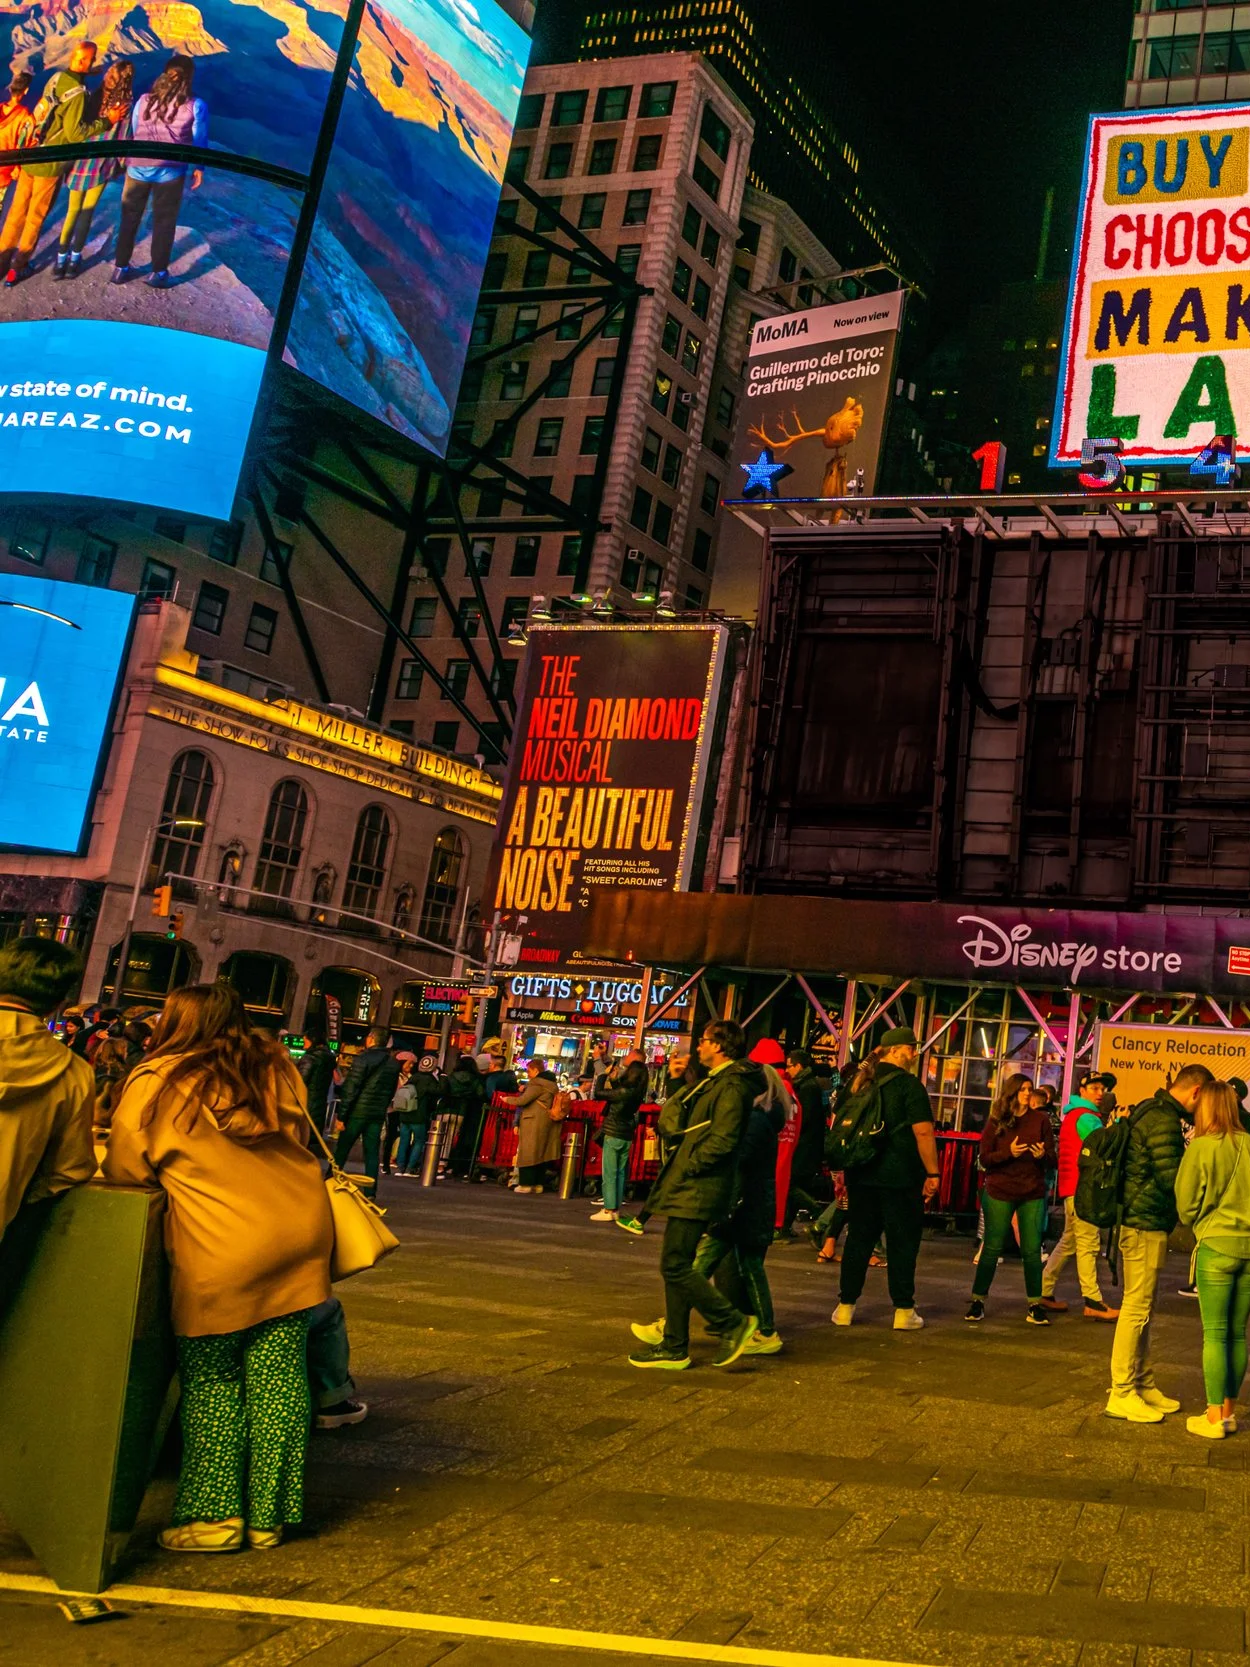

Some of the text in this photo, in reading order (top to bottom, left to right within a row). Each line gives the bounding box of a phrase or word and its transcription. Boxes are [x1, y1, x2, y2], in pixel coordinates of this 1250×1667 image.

[1117, 134, 1233, 195] BUY
[756, 310, 890, 344] MoMA Now on view
[747, 361, 880, 398] Crafting Pinocchio
[750, 346, 884, 381] Guillermo del Toro:
[10, 380, 71, 397] state
[75, 381, 107, 399] of
[110, 386, 193, 413] mind.
[0, 411, 192, 444] AREAZ.COM
[539, 655, 581, 696] THE
[528, 697, 702, 741] NEIL DIAMOND
[172, 704, 200, 726] THE
[203, 716, 245, 740] SHOW
[250, 732, 289, 756] FOLKS
[295, 747, 329, 769] SHOE
[331, 759, 363, 779] SHOP
[316, 714, 384, 754] MILLER
[401, 744, 473, 785] BUILDING
[520, 740, 613, 783] MUSICAL
[505, 786, 675, 851] A BEAUTIFUL
[495, 849, 580, 912] NOISE
[1102, 944, 1181, 974] store
[511, 976, 572, 999] GIFTS
[517, 1011, 534, 1020] Apple
[539, 1011, 567, 1022] Nikon
[571, 1014, 605, 1025] Canon
[612, 1017, 639, 1027] SON
[1111, 1036, 1161, 1056] Clancy
[1166, 1039, 1246, 1058] Relocation
[1110, 1058, 1186, 1073] New York, NY
